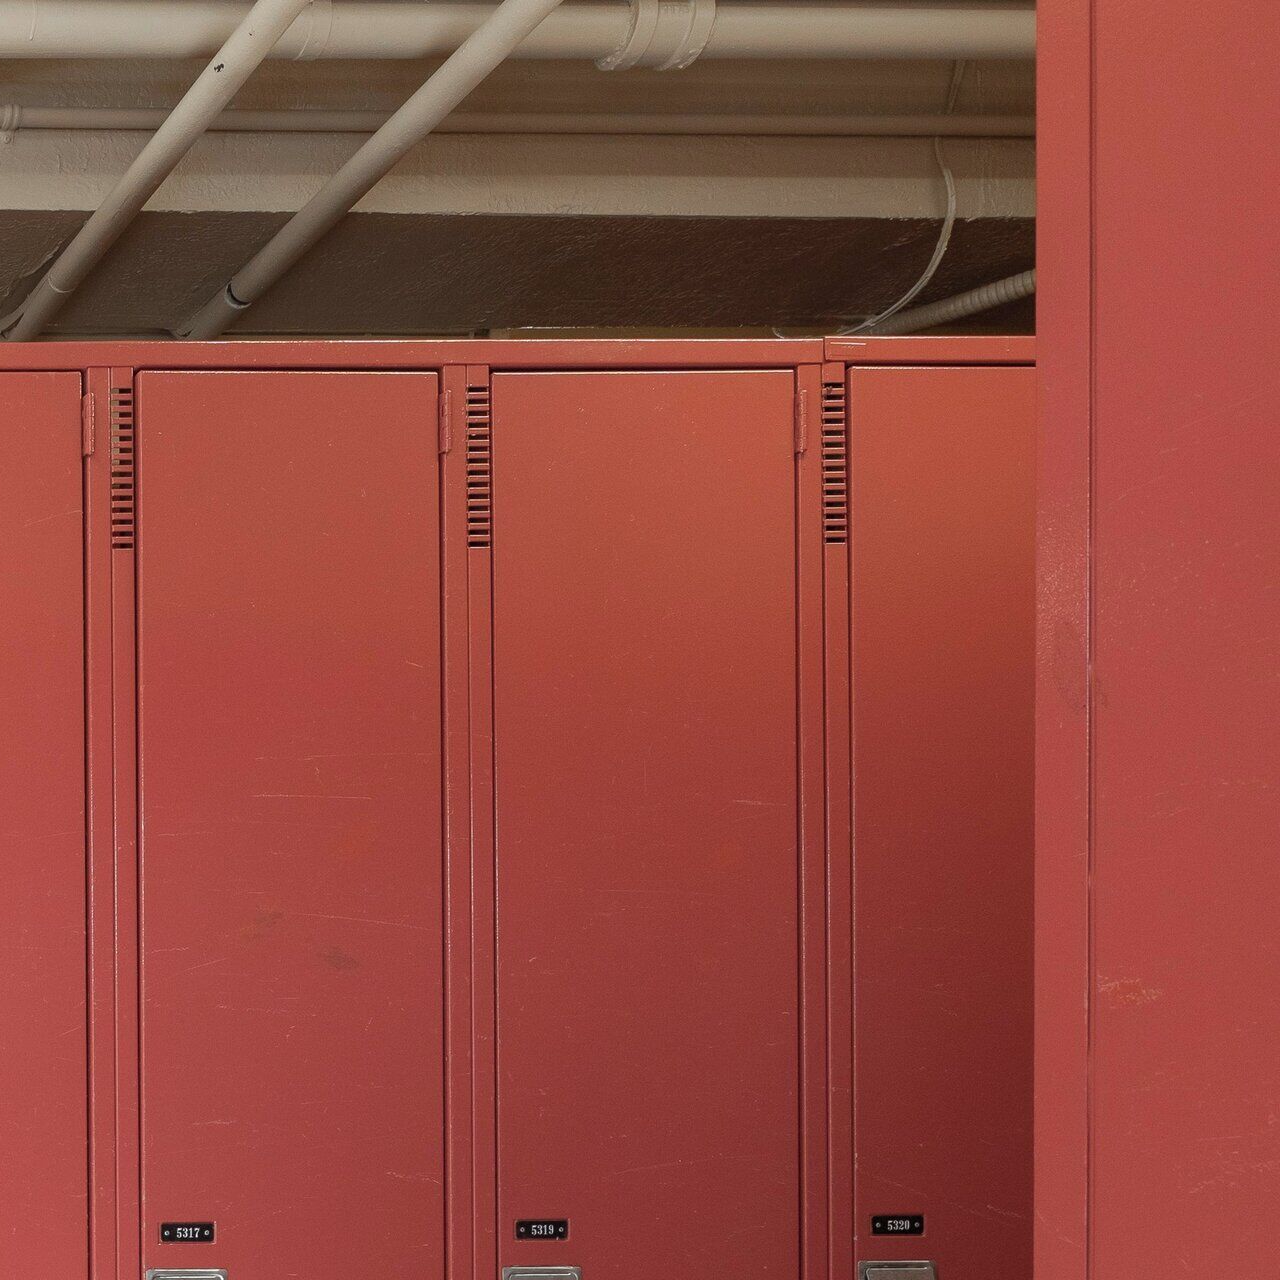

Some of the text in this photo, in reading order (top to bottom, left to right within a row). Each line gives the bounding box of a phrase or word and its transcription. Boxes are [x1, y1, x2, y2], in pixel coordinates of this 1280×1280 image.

[531, 1224, 554, 1235] 5319
[887, 1220, 910, 1231] 5320
[176, 1227, 200, 1238] 5317
